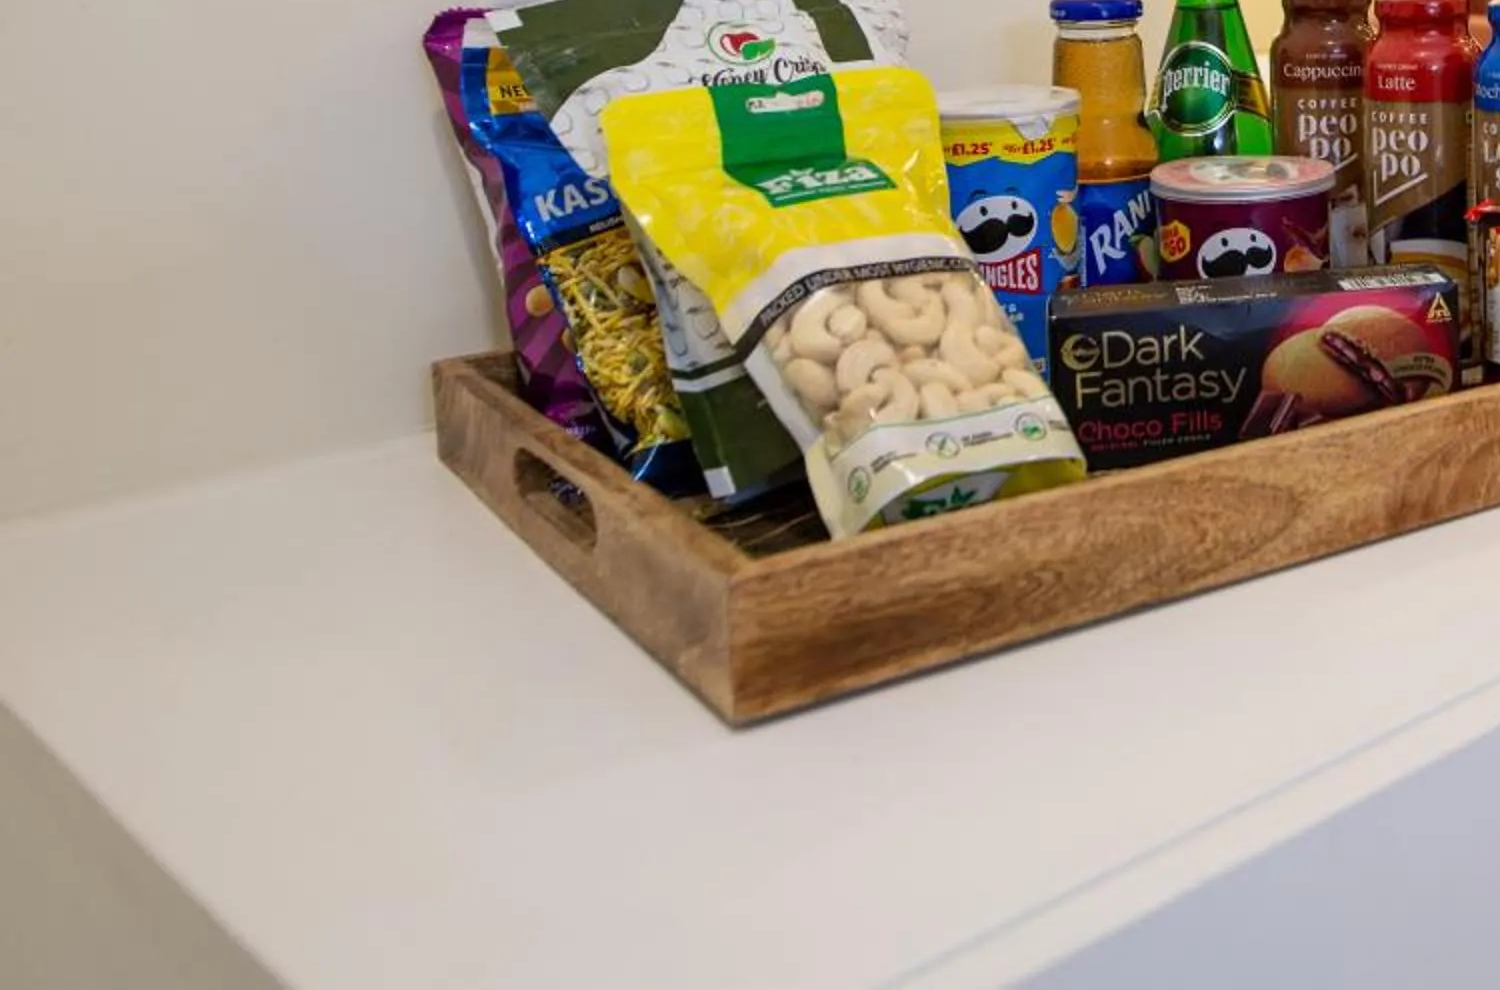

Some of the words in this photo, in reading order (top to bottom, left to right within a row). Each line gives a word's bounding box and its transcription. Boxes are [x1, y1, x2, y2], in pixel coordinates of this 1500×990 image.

[1161, 60, 1230, 112] perrier
[1283, 62, 1362, 82] Cappuccin
[1377, 74, 1416, 91] Latte
[1297, 97, 1358, 109] COFFEE
[1371, 111, 1428, 124] COFFEE
[1299, 113, 1357, 142] peo
[1372, 127, 1428, 155] peo
[1381, 153, 1421, 181] po
[534, 178, 610, 222] KAS
[1089, 190, 1151, 277] RANI
[1102, 324, 1205, 370] Dark
[1075, 367, 1247, 410] Fantasy
[1078, 419, 1163, 443] Choco
[1171, 411, 1223, 433] Fills
